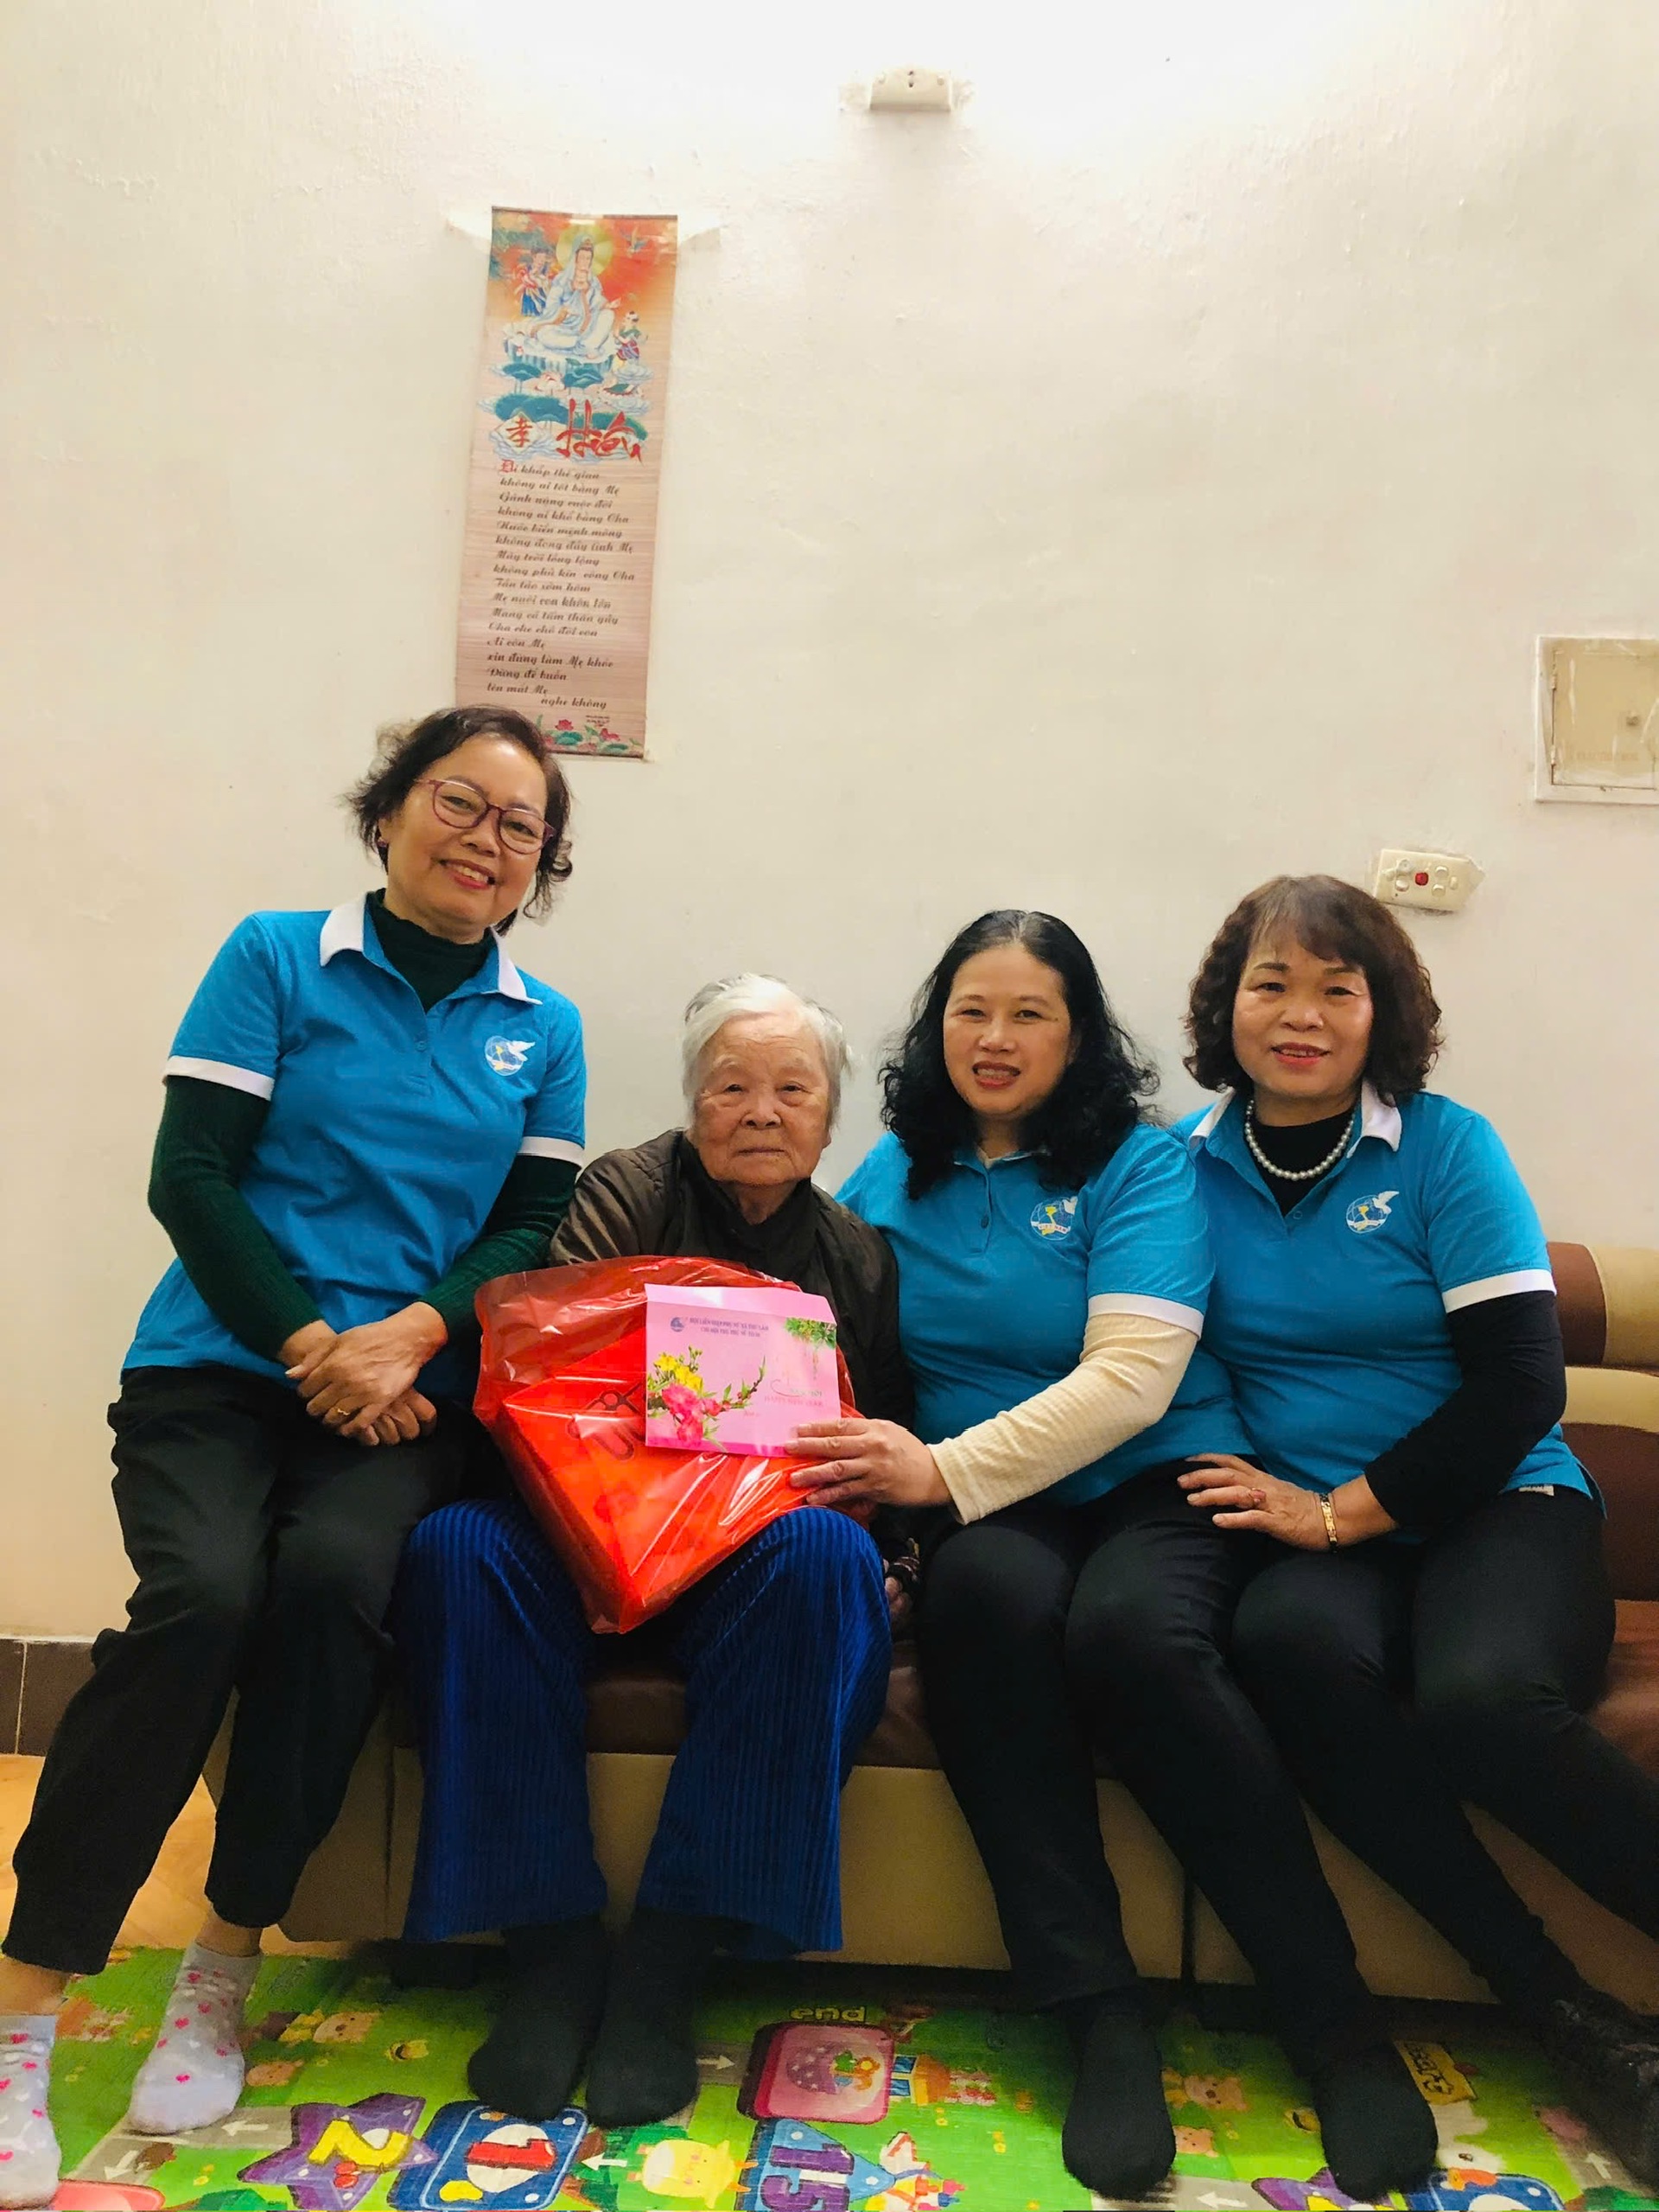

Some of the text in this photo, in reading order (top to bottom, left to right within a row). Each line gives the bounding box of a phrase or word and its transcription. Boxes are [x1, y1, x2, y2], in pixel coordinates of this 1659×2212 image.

[506, 416, 532, 448] 孝
[574, 471, 600, 480] gian
[605, 485, 620, 497] Mẹ
[607, 513, 629, 524] Cha
[620, 542, 633, 555] Mẹ
[613, 571, 635, 581] Cha
[539, 597, 558, 606] con
[492, 607, 523, 619] Mang
[489, 622, 511, 632] Cha
[514, 624, 532, 632] che
[486, 637, 505, 646] Ai
[528, 639, 545, 650] Mẹ
[487, 652, 505, 661] xin
[541, 654, 563, 664] làm
[567, 655, 583, 669] Mẹ
[533, 685, 549, 696] Mẹ
[541, 696, 568, 706] nghe
[790, 2006, 865, 2022] end
